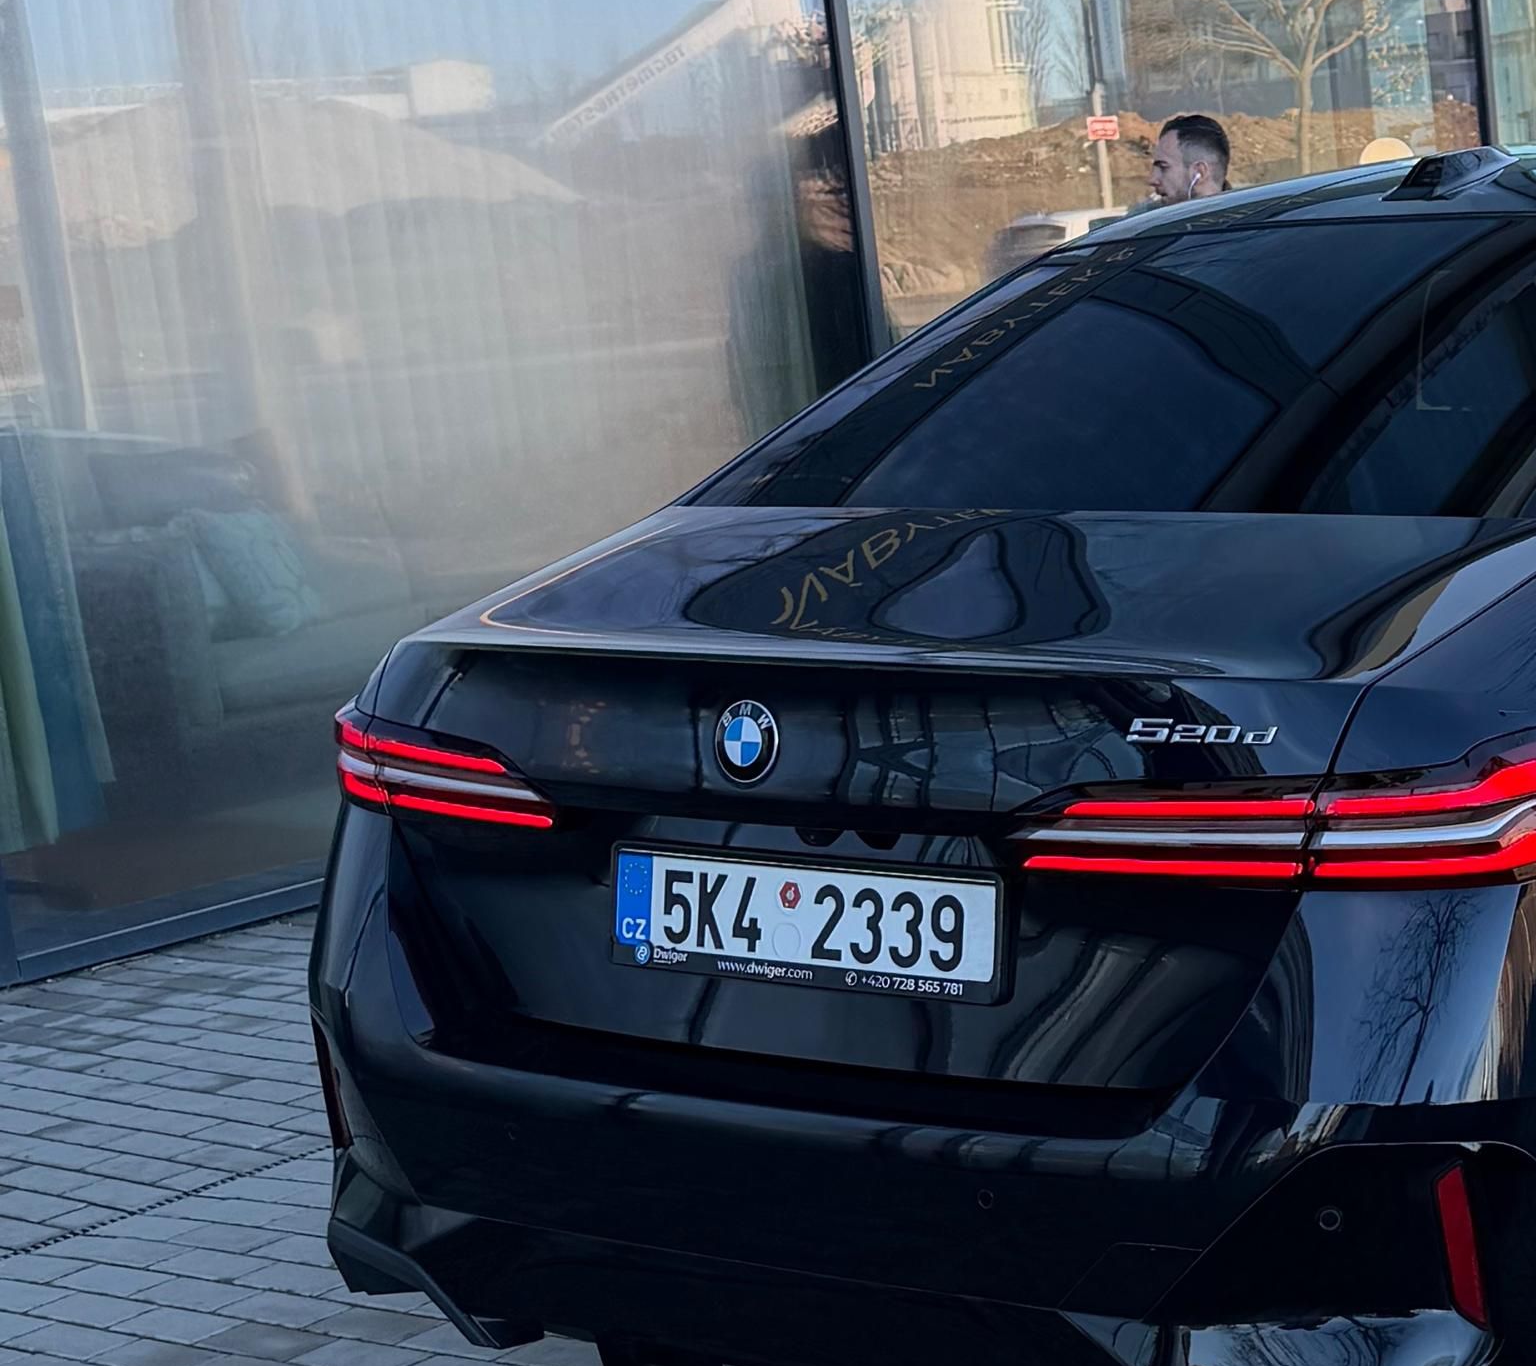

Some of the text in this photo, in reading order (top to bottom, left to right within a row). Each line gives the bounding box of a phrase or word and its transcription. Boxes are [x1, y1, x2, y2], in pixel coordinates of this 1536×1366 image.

[722, 703, 772, 730] BMW
[621, 916, 647, 941] CZ
[662, 869, 965, 973] 5K4 2339
[653, 947, 689, 964] Dwiger
[717, 960, 813, 981] www.dwiger.com
[861, 974, 963, 996] +420 728 565 781
